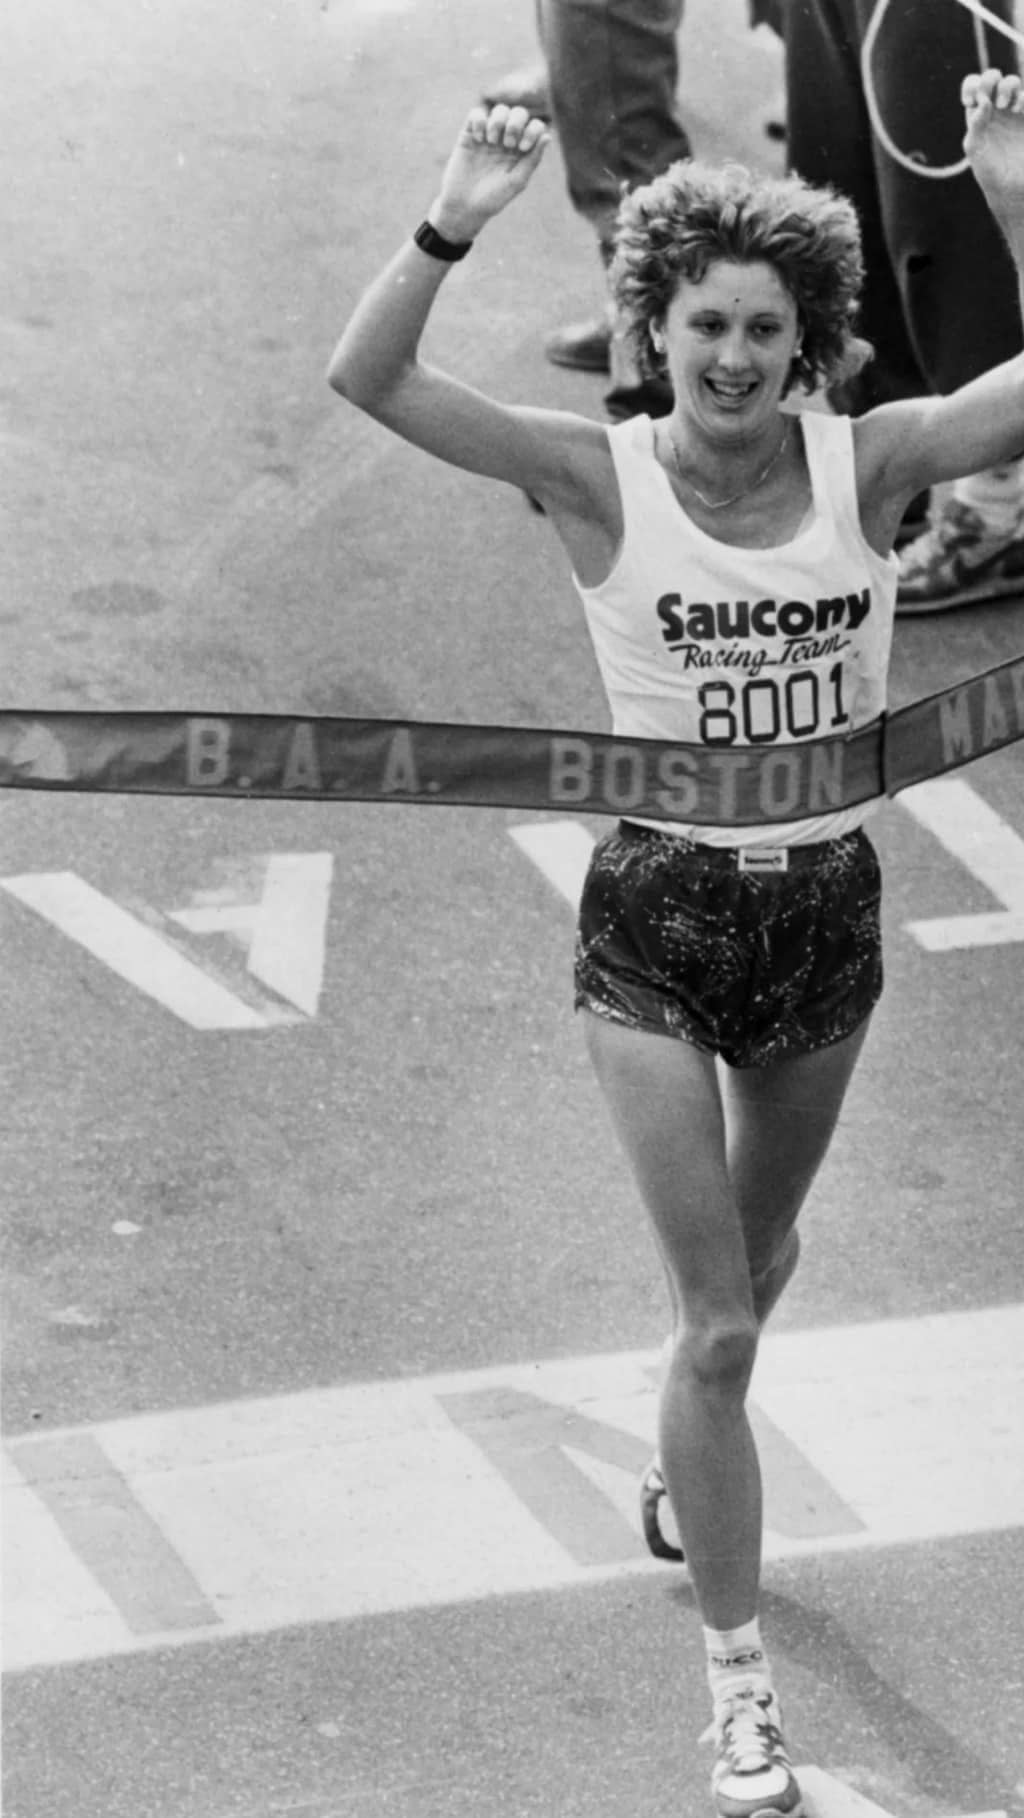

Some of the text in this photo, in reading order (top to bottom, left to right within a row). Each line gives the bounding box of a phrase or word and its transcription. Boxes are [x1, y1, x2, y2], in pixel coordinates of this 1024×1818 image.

[656, 588, 871, 642] Saucony
[668, 633, 851, 677] Racing Team
[698, 662, 849, 746] 8001
[186, 717, 251, 788] B.
[282, 722, 348, 791] A.
[381, 727, 441, 793] A.
[550, 738, 845, 820] BOSTON
